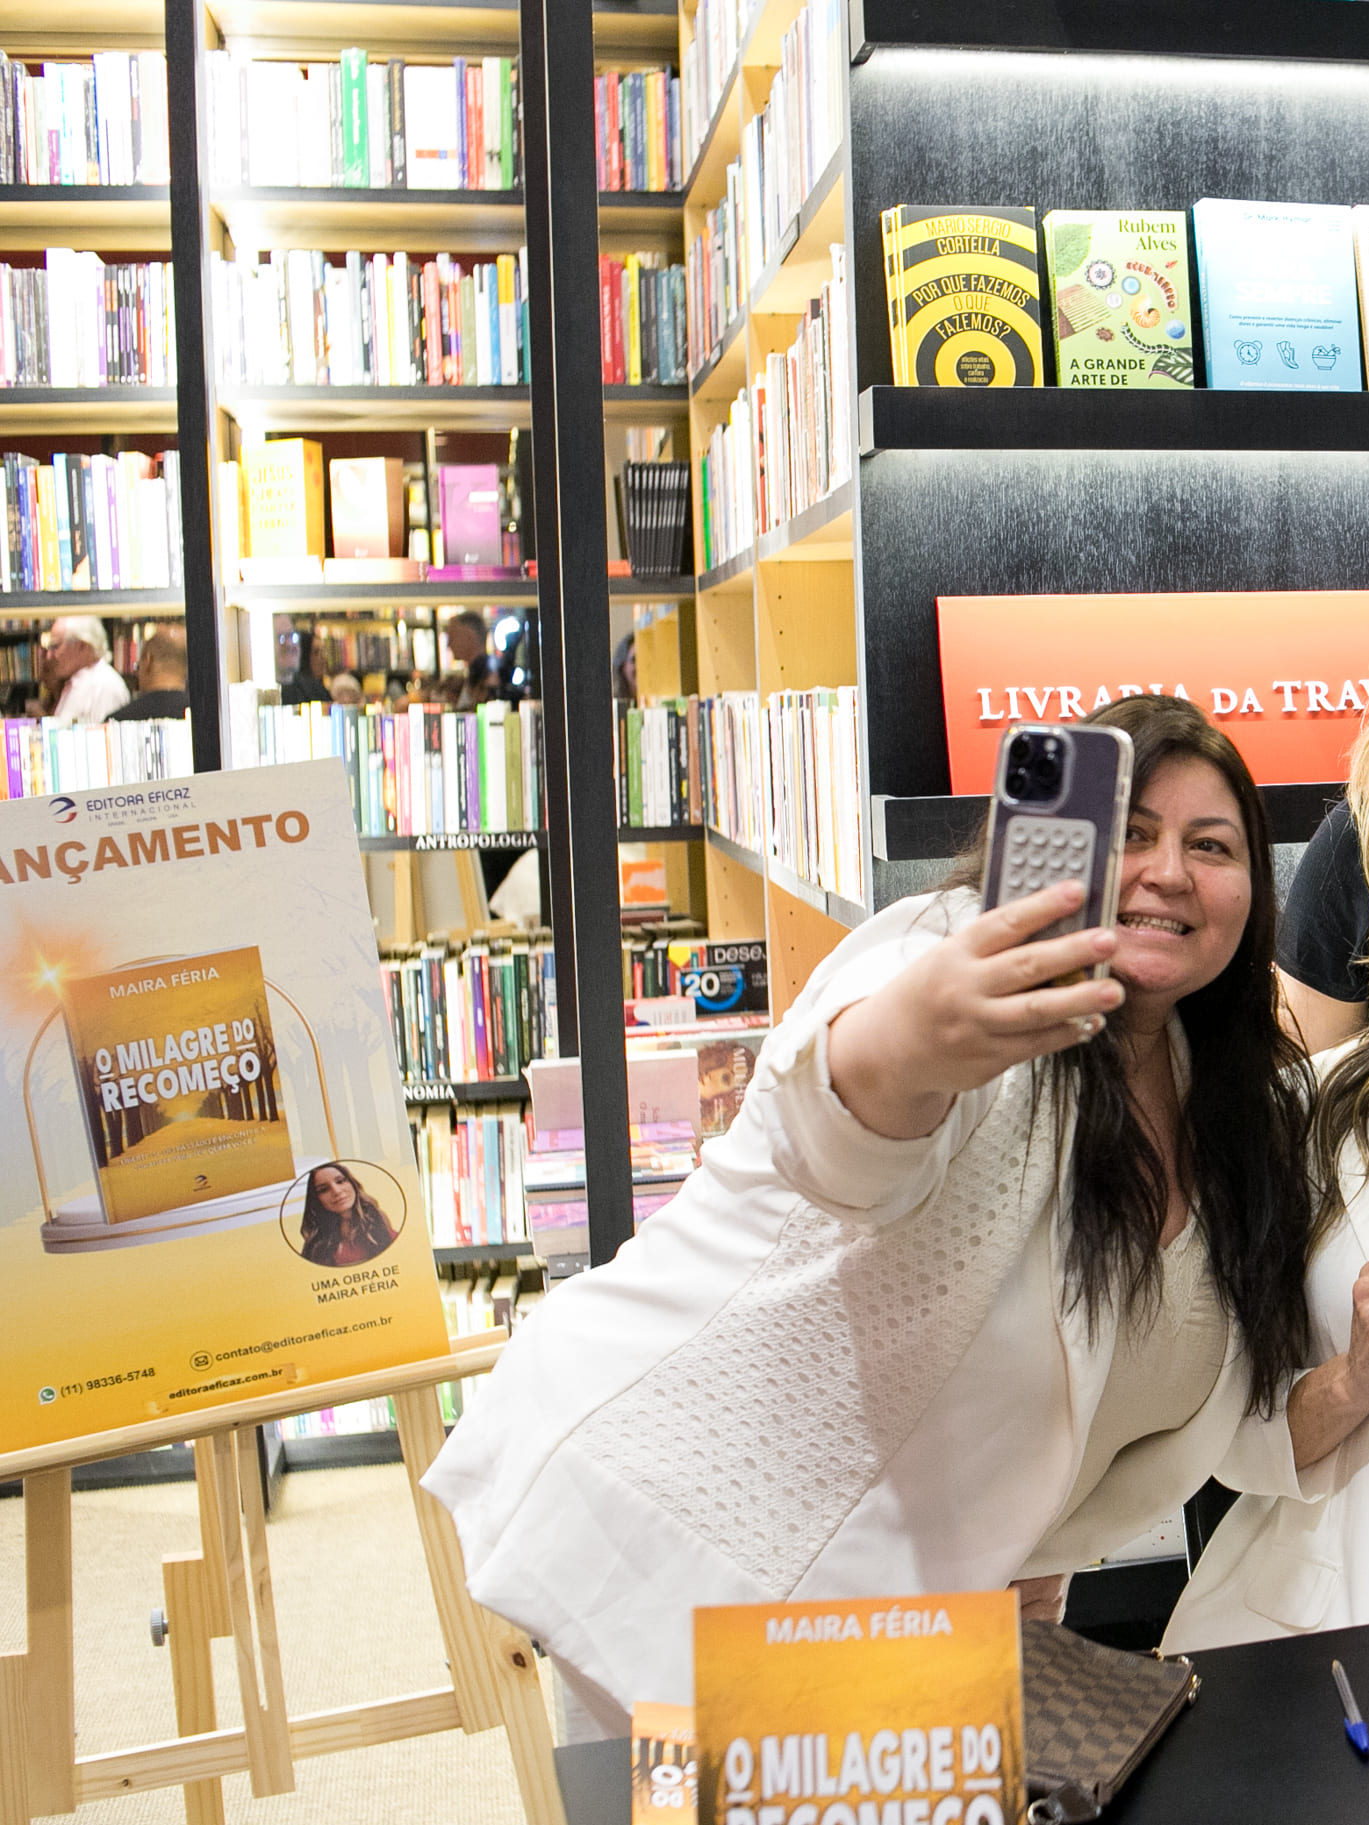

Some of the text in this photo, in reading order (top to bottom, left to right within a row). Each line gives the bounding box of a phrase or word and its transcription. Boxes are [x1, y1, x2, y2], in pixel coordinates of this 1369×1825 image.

[925, 216, 1012, 239] MARIO SERGIO
[1119, 218, 1176, 234] Rubem
[936, 235, 1001, 257] CORTELLA
[1135, 235, 1177, 251] Alves
[911, 274, 1031, 308] POR QUE FAZEMOS
[953, 295, 992, 312] O QUE
[934, 313, 1012, 340] FAZEMOS?
[1070, 358, 1146, 370] A GRANDE
[1071, 374, 1129, 386] ARTE DE
[1212, 687, 1264, 715] DA
[86, 787, 192, 812] EDITORA EFICAZ
[88, 801, 198, 823] INTERNACIONAL
[415, 832, 538, 850] ANTROPOLOGIA
[109, 966, 220, 999] MAIRA FÉRIA
[684, 972, 721, 998] 20
[96, 1017, 255, 1075] O MILAGRE DO
[99, 1051, 262, 1113] RECOMEÇO
[402, 1084, 456, 1101] NOMIA
[311, 1264, 400, 1292] UMA OBRA DE
[317, 1278, 399, 1304] MAIRA FÉRIA
[215, 1316, 393, 1362] contato@editoraeficaz.com.br
[60, 1367, 156, 1398] (11) 98336-5748
[168, 1368, 283, 1400] editoraeficaz.com.br
[765, 1604, 953, 1645] MAIRA FÉRIA
[725, 1737, 755, 1791] O
[761, 1725, 956, 1799] MILAGRE
[960, 1723, 1002, 1775] DO
